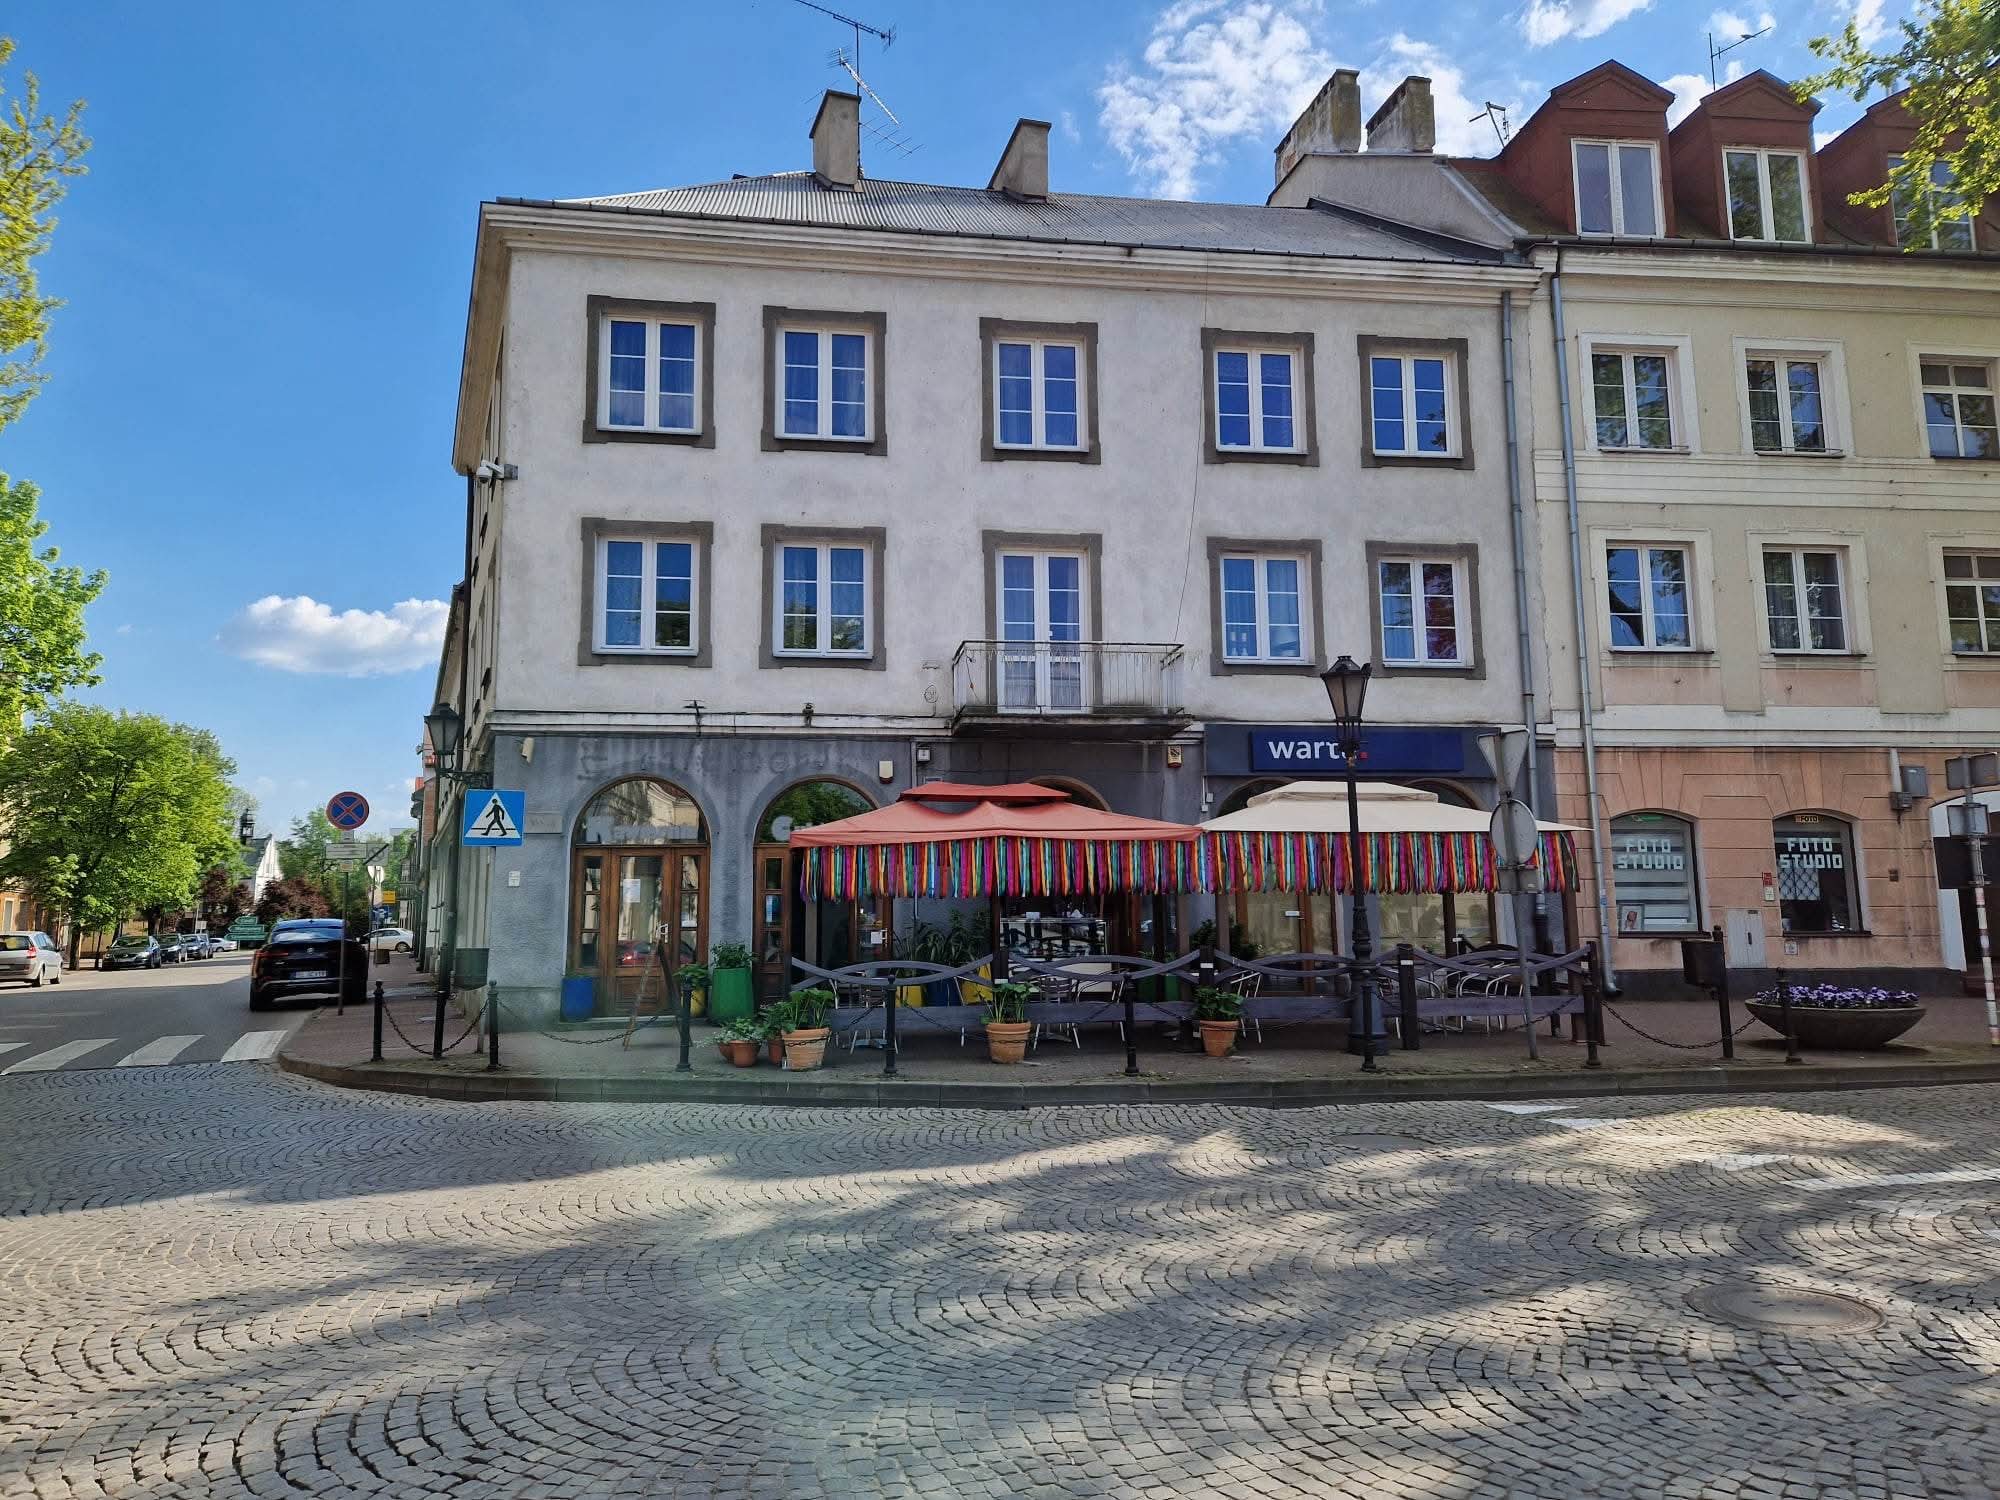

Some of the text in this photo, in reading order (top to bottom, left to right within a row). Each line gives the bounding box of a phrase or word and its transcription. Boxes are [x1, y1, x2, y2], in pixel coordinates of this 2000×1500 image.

[1268, 741, 1357, 760] wart
[1625, 838, 1671, 853] FOTO
[1786, 838, 1833, 852] FOTO
[1617, 854, 1684, 870] STUDIO
[1780, 854, 1843, 869] STUDIO
